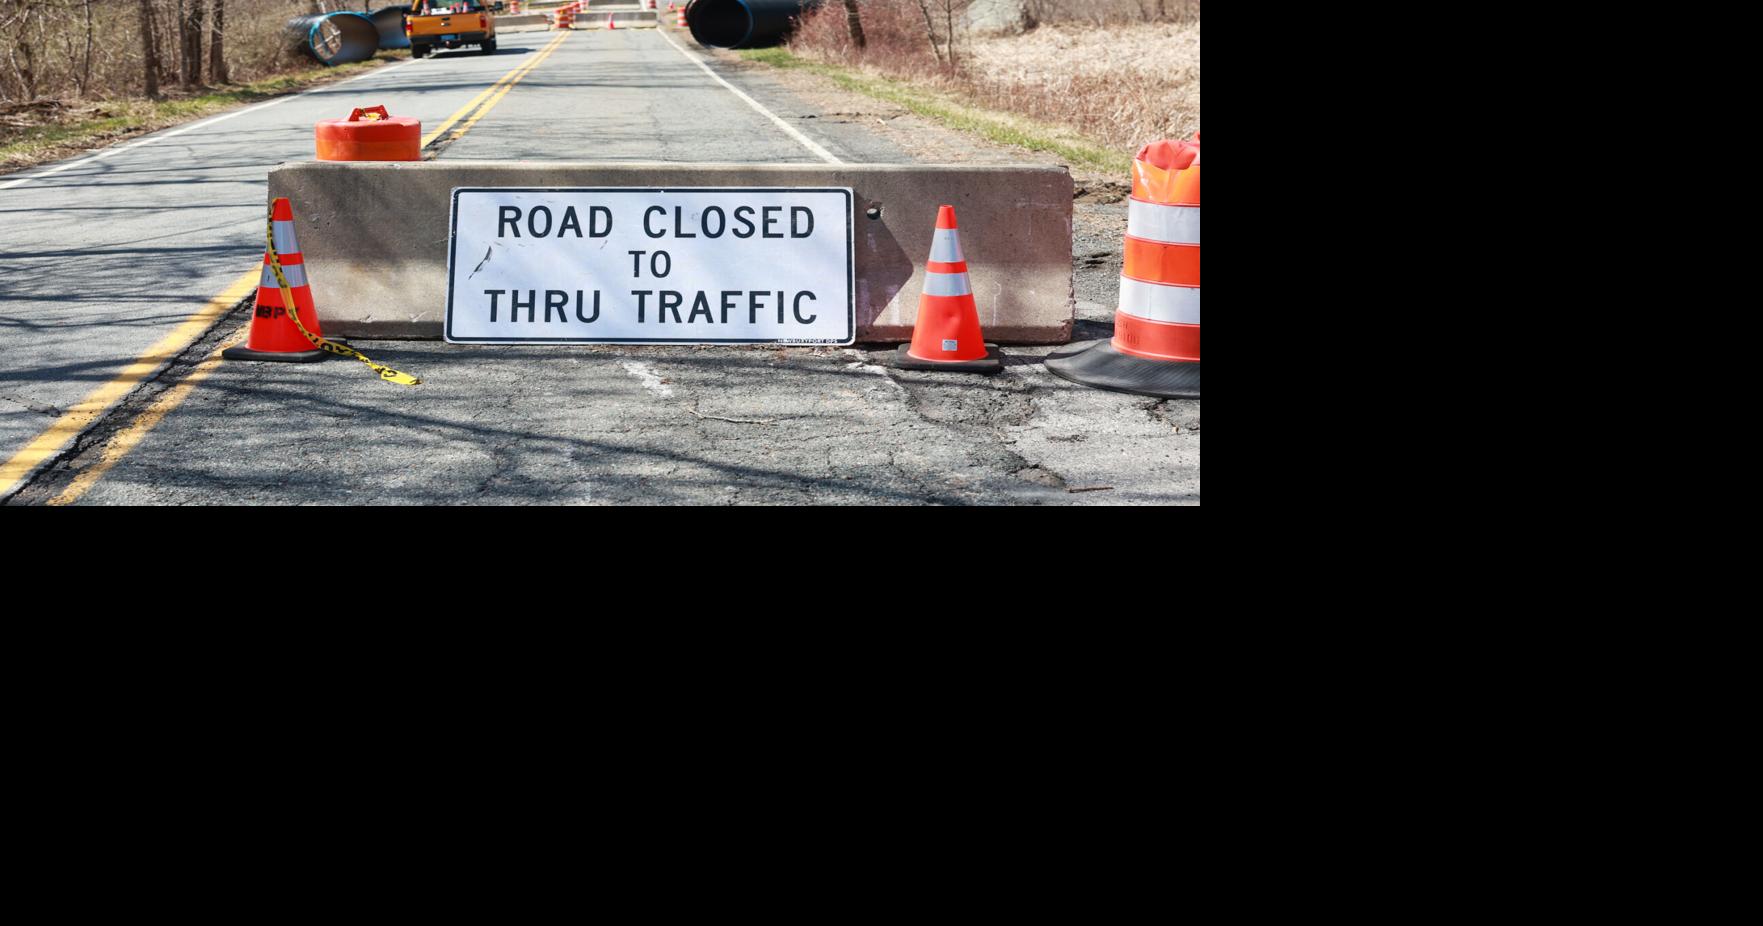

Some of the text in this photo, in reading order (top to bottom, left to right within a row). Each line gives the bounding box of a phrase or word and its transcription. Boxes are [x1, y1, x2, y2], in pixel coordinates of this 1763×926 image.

[498, 205, 815, 239] ROAD CLOSED
[628, 250, 672, 279] TO
[484, 289, 817, 325] THRU TRAFFIC
